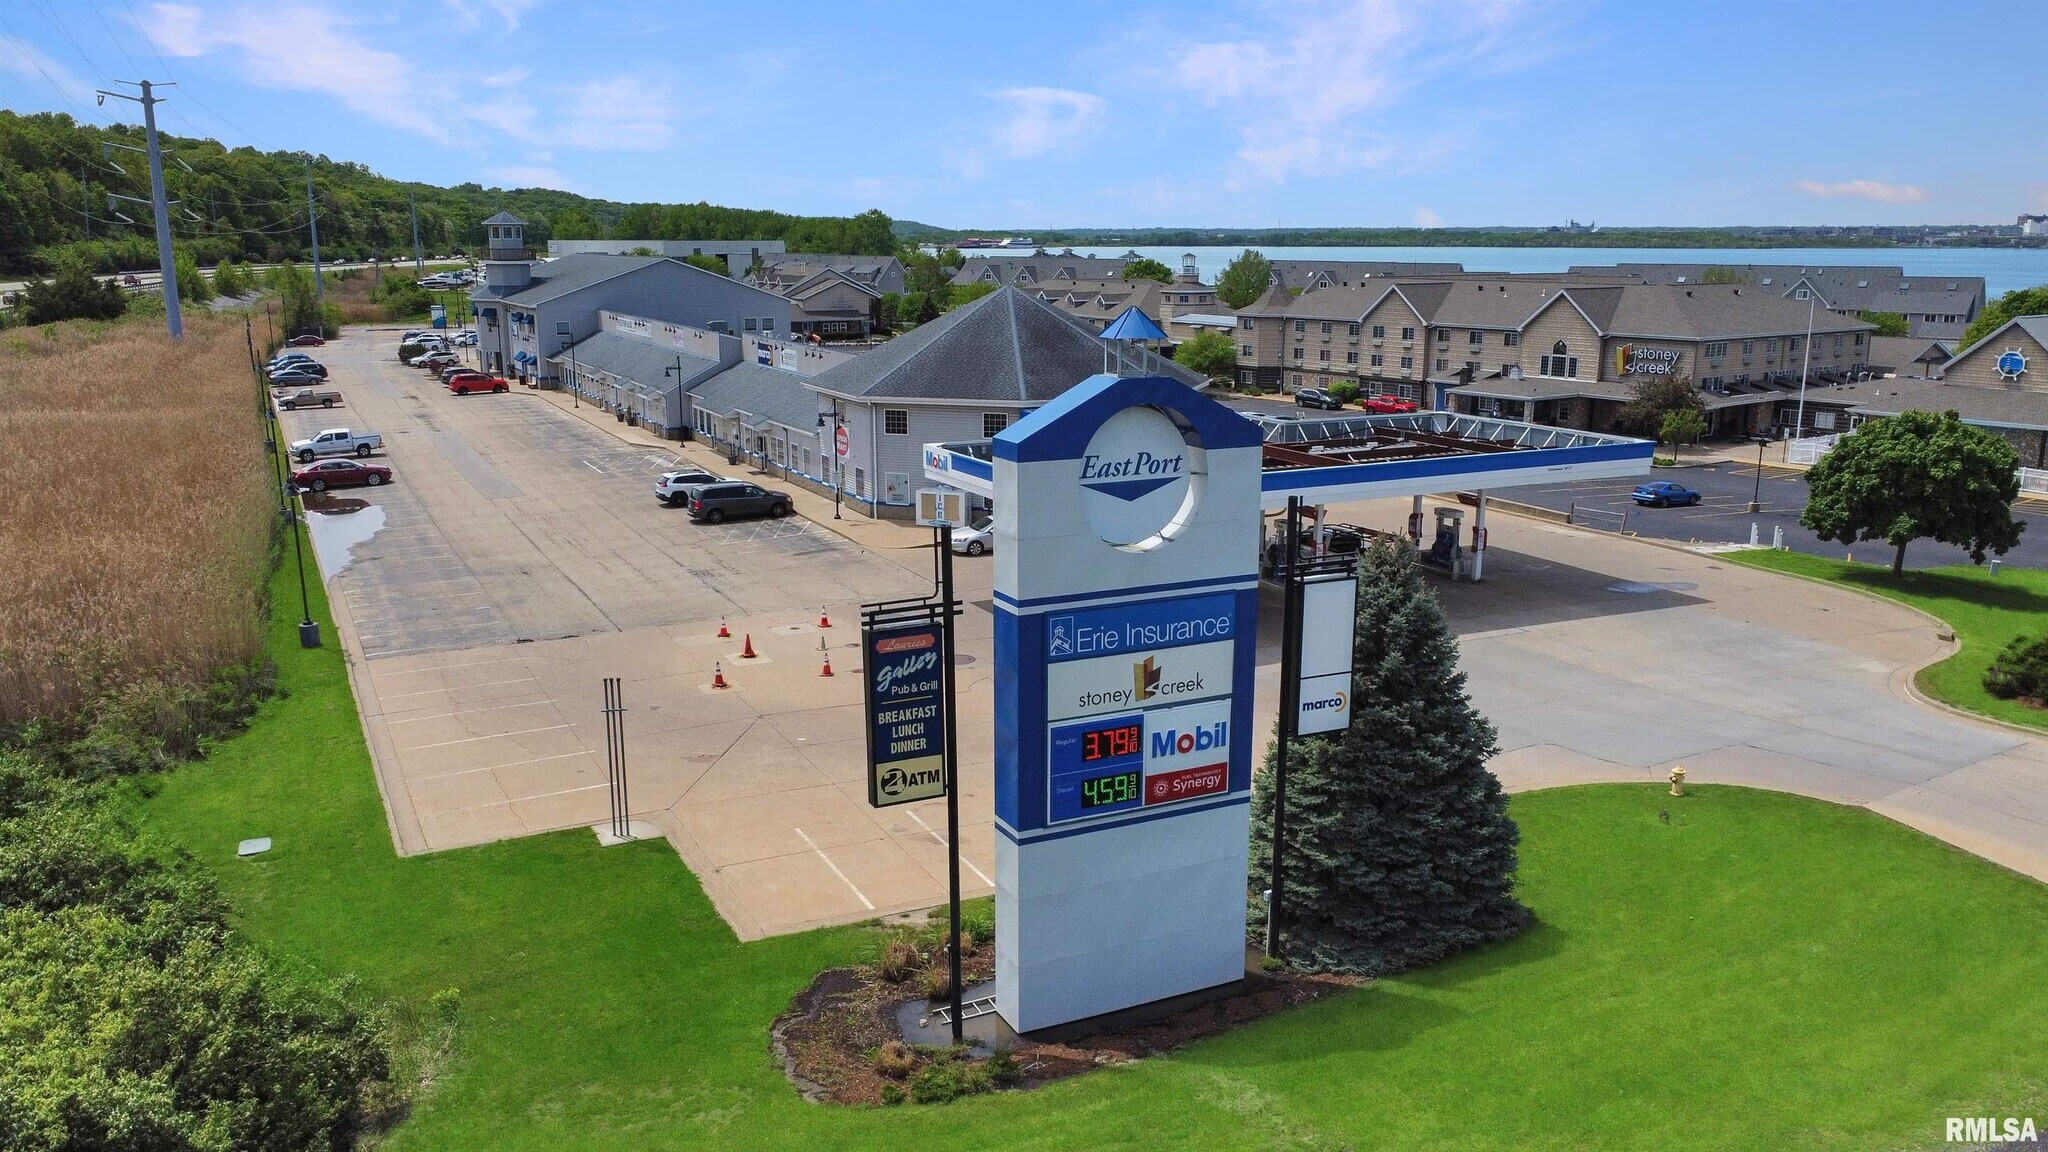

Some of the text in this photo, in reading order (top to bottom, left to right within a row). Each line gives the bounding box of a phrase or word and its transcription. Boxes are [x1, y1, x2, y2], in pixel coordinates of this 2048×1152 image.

[1637, 346, 1680, 366] stoney
[1637, 361, 1671, 375] creek
[925, 450, 949, 472] Mobil
[1077, 616, 1230, 653] Erie Insurance
[877, 651, 938, 692] Galley
[891, 680, 938, 696] Pub & Grill
[1078, 672, 1205, 708] stoney creek
[1302, 697, 1342, 711] marco
[878, 705, 937, 725] BREAKFAST
[892, 722, 924, 738] LUNCH
[890, 738, 927, 754] DINNER
[1055, 738, 1077, 746] Regular
[1151, 721, 1227, 759] Mobil
[908, 769, 940, 787] ATM
[1172, 774, 1222, 793] Synergy
[1056, 786, 1074, 794] Diesel
